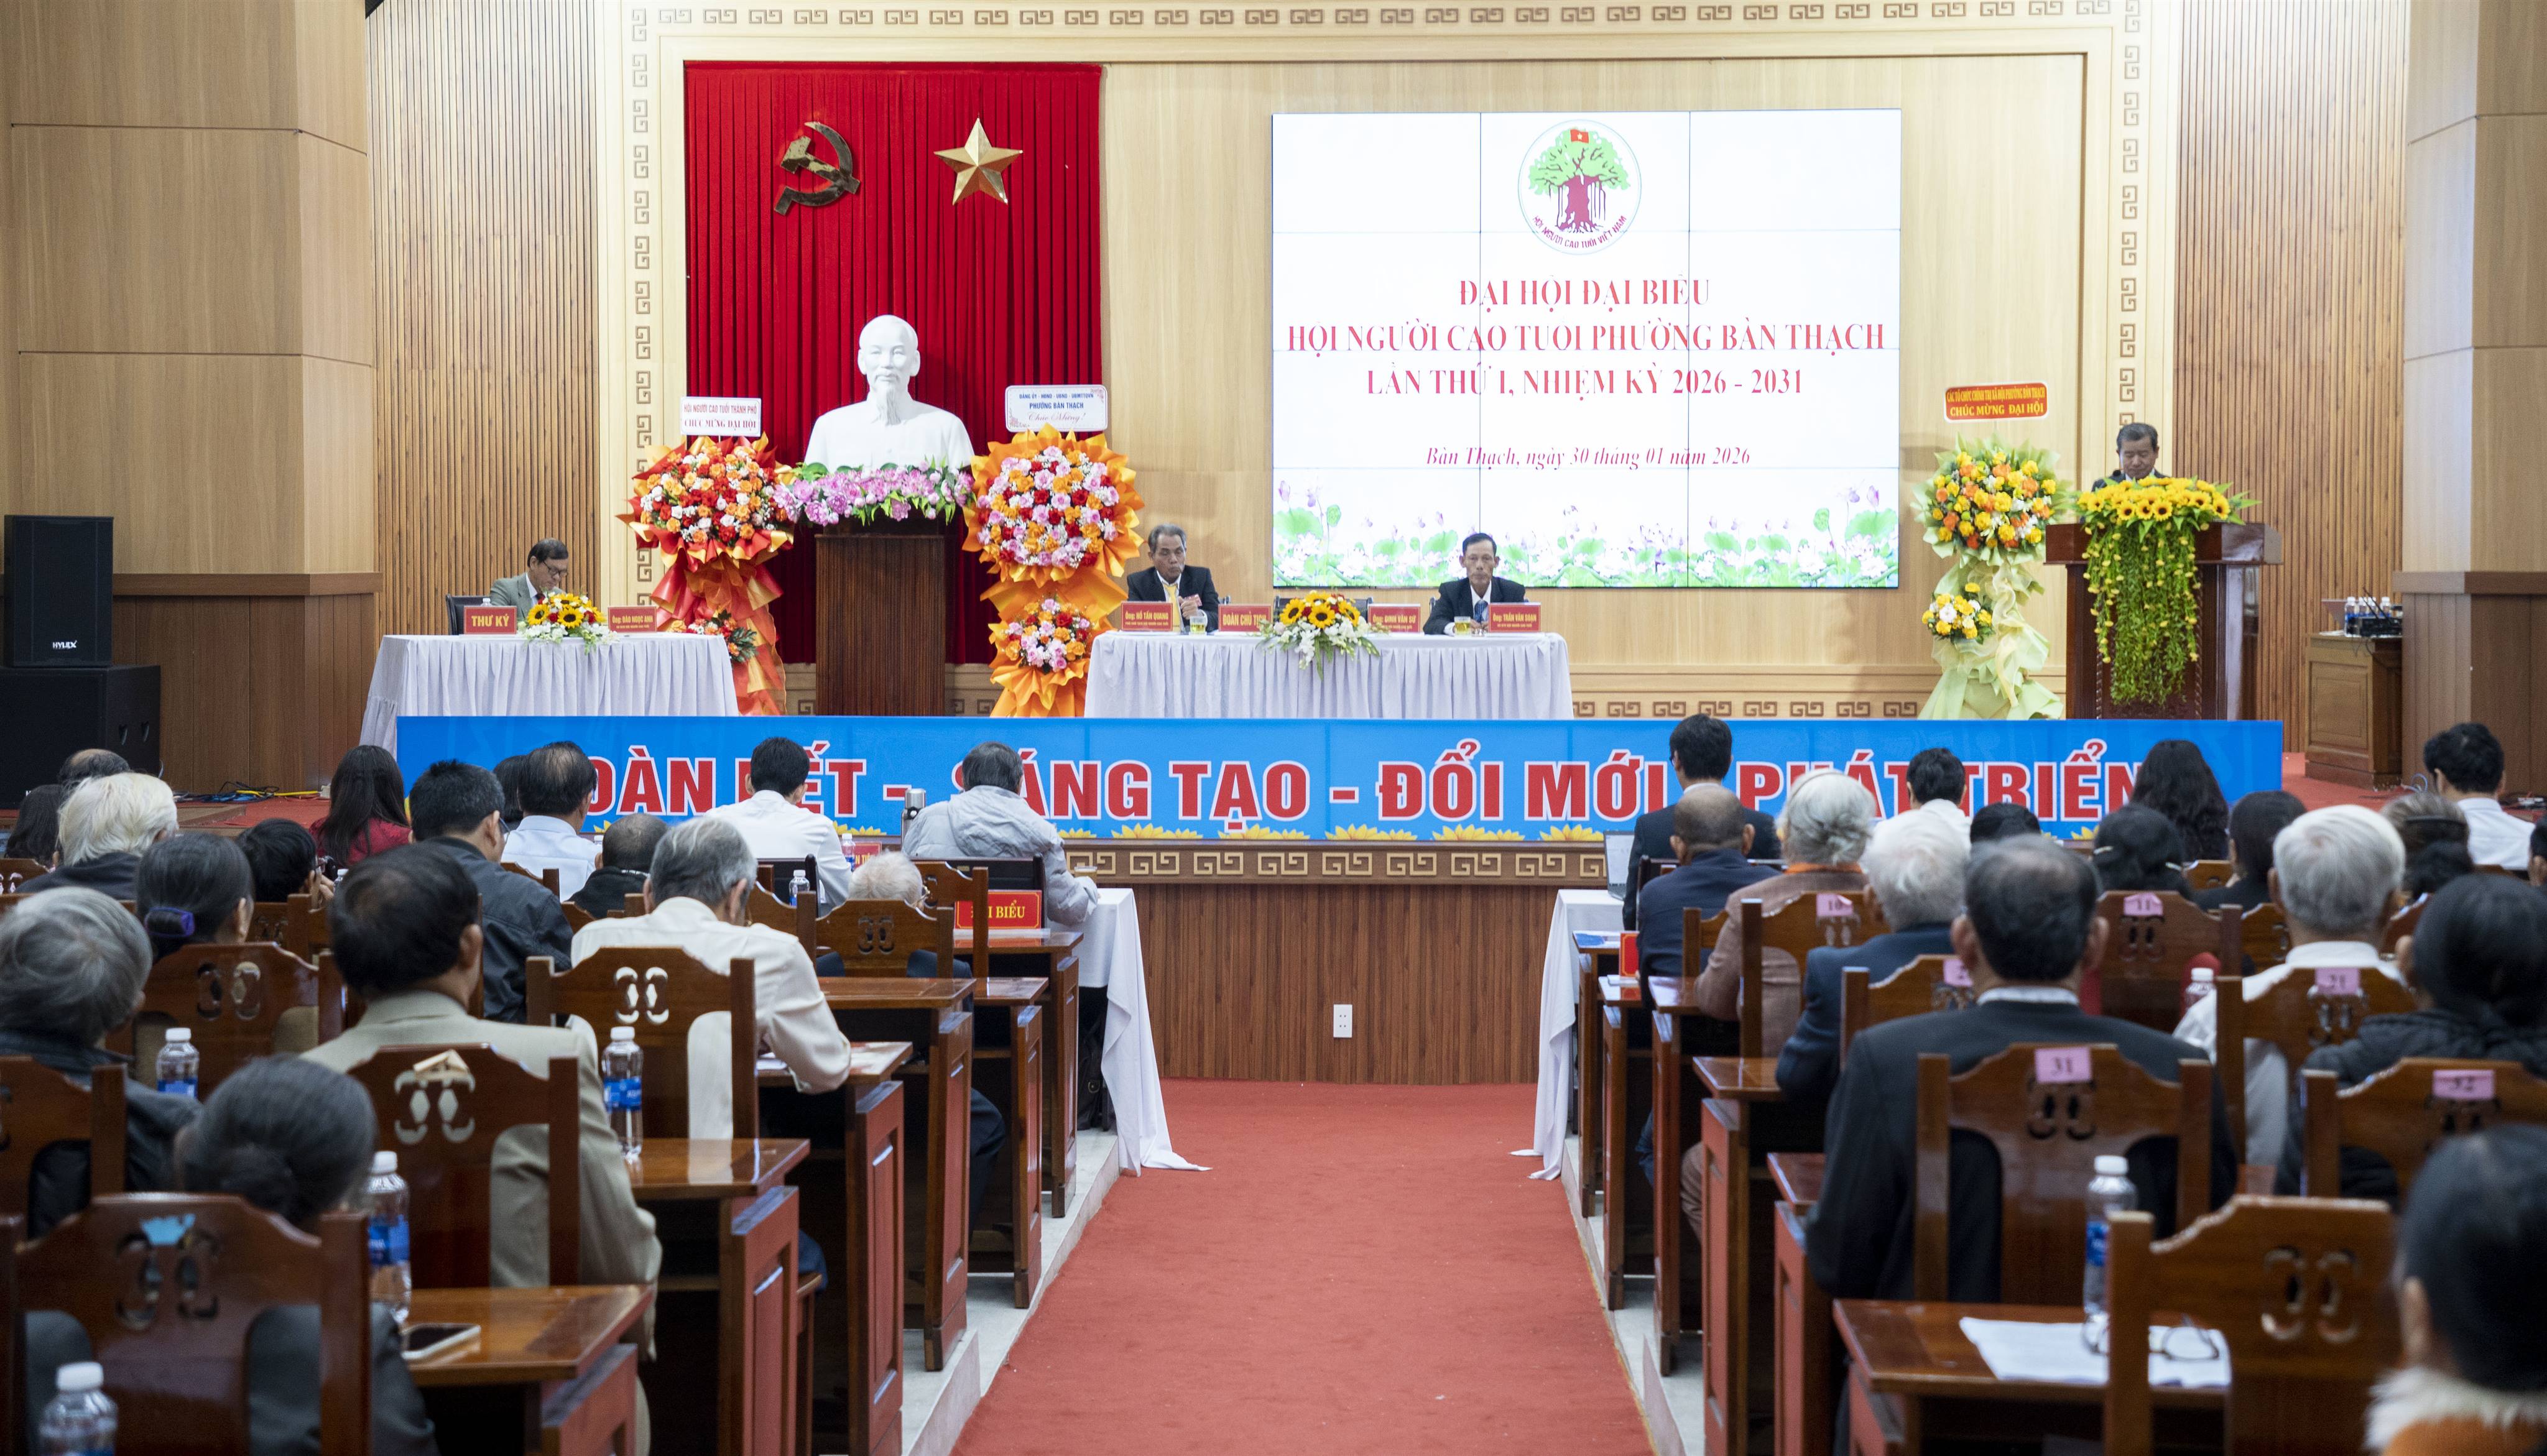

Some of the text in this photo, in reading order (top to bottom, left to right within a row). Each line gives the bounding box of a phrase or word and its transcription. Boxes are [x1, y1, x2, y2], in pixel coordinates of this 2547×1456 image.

[1565, 239, 1579, 248] CAO
[1612, 216, 1627, 233] NAM
[1459, 280, 1508, 313] ĐẠI
[1521, 275, 1571, 313] HỘI
[1583, 280, 1630, 313] ĐẠI
[1288, 321, 1338, 357] HỘI
[1347, 318, 1438, 351] NGƯỜI
[1447, 325, 1507, 351] CAO
[1591, 318, 1711, 350] PHƯỜNG
[1722, 317, 1776, 350] BÀN
[1785, 324, 1884, 356] THẠCH
[1368, 362, 1420, 394] LẦN
[1430, 362, 1492, 395] THỨ
[1500, 370, 1514, 396] I,
[1524, 366, 1614, 401] NHIỆM
[1626, 362, 1662, 394] KỲ
[1673, 369, 1727, 394] 2026
[1751, 369, 1801, 394] 2031
[709, 405, 718, 413] CAO
[1949, 401, 2044, 417] CHÚC MỪNG ĐẠI HỘI
[1426, 446, 1750, 471] Bàn Thạch, ngày 30 tháng 01 năm 2026
[471, 614, 510, 627] THƯ KÝ
[1223, 612, 1239, 626] ĐOÀN
[1241, 611, 1252, 626] CHỦ
[587, 745, 716, 816] OÀN
[883, 784, 912, 801] -
[951, 748, 1152, 820] ÁNG
[1168, 760, 1310, 832] TẠO
[1329, 786, 1359, 804] -
[1375, 737, 1504, 821] ĐỔI
[1524, 749, 1668, 821] MỚI
[1736, 749, 1910, 819] PÁT
[996, 900, 1025, 918] BIỂU
